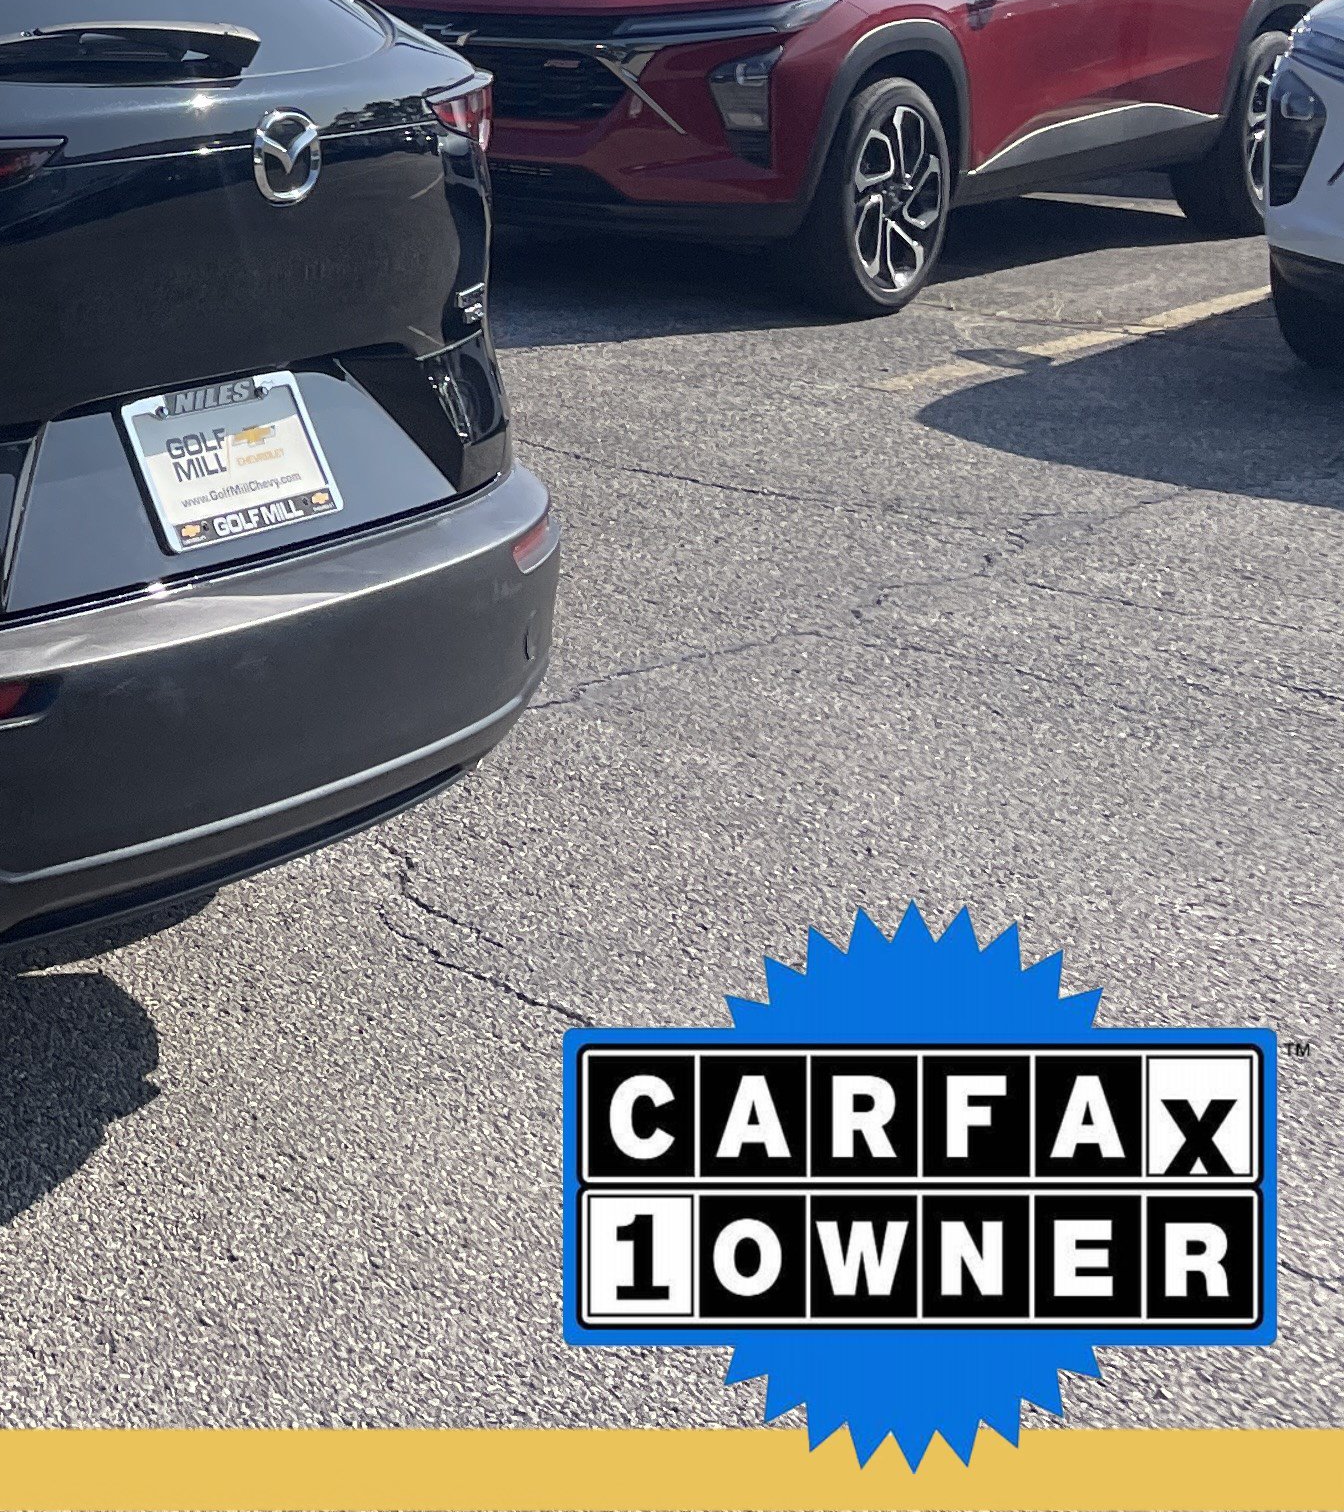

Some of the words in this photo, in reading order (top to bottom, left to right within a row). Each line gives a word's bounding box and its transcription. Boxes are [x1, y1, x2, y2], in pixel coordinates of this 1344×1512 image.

[173, 379, 252, 415] NILES
[165, 427, 227, 460] GOLF
[171, 452, 228, 483] MILL
[181, 472, 302, 508] www.GolfMillChevy.com
[212, 509, 260, 538] GOLF
[257, 499, 305, 525] MILL
